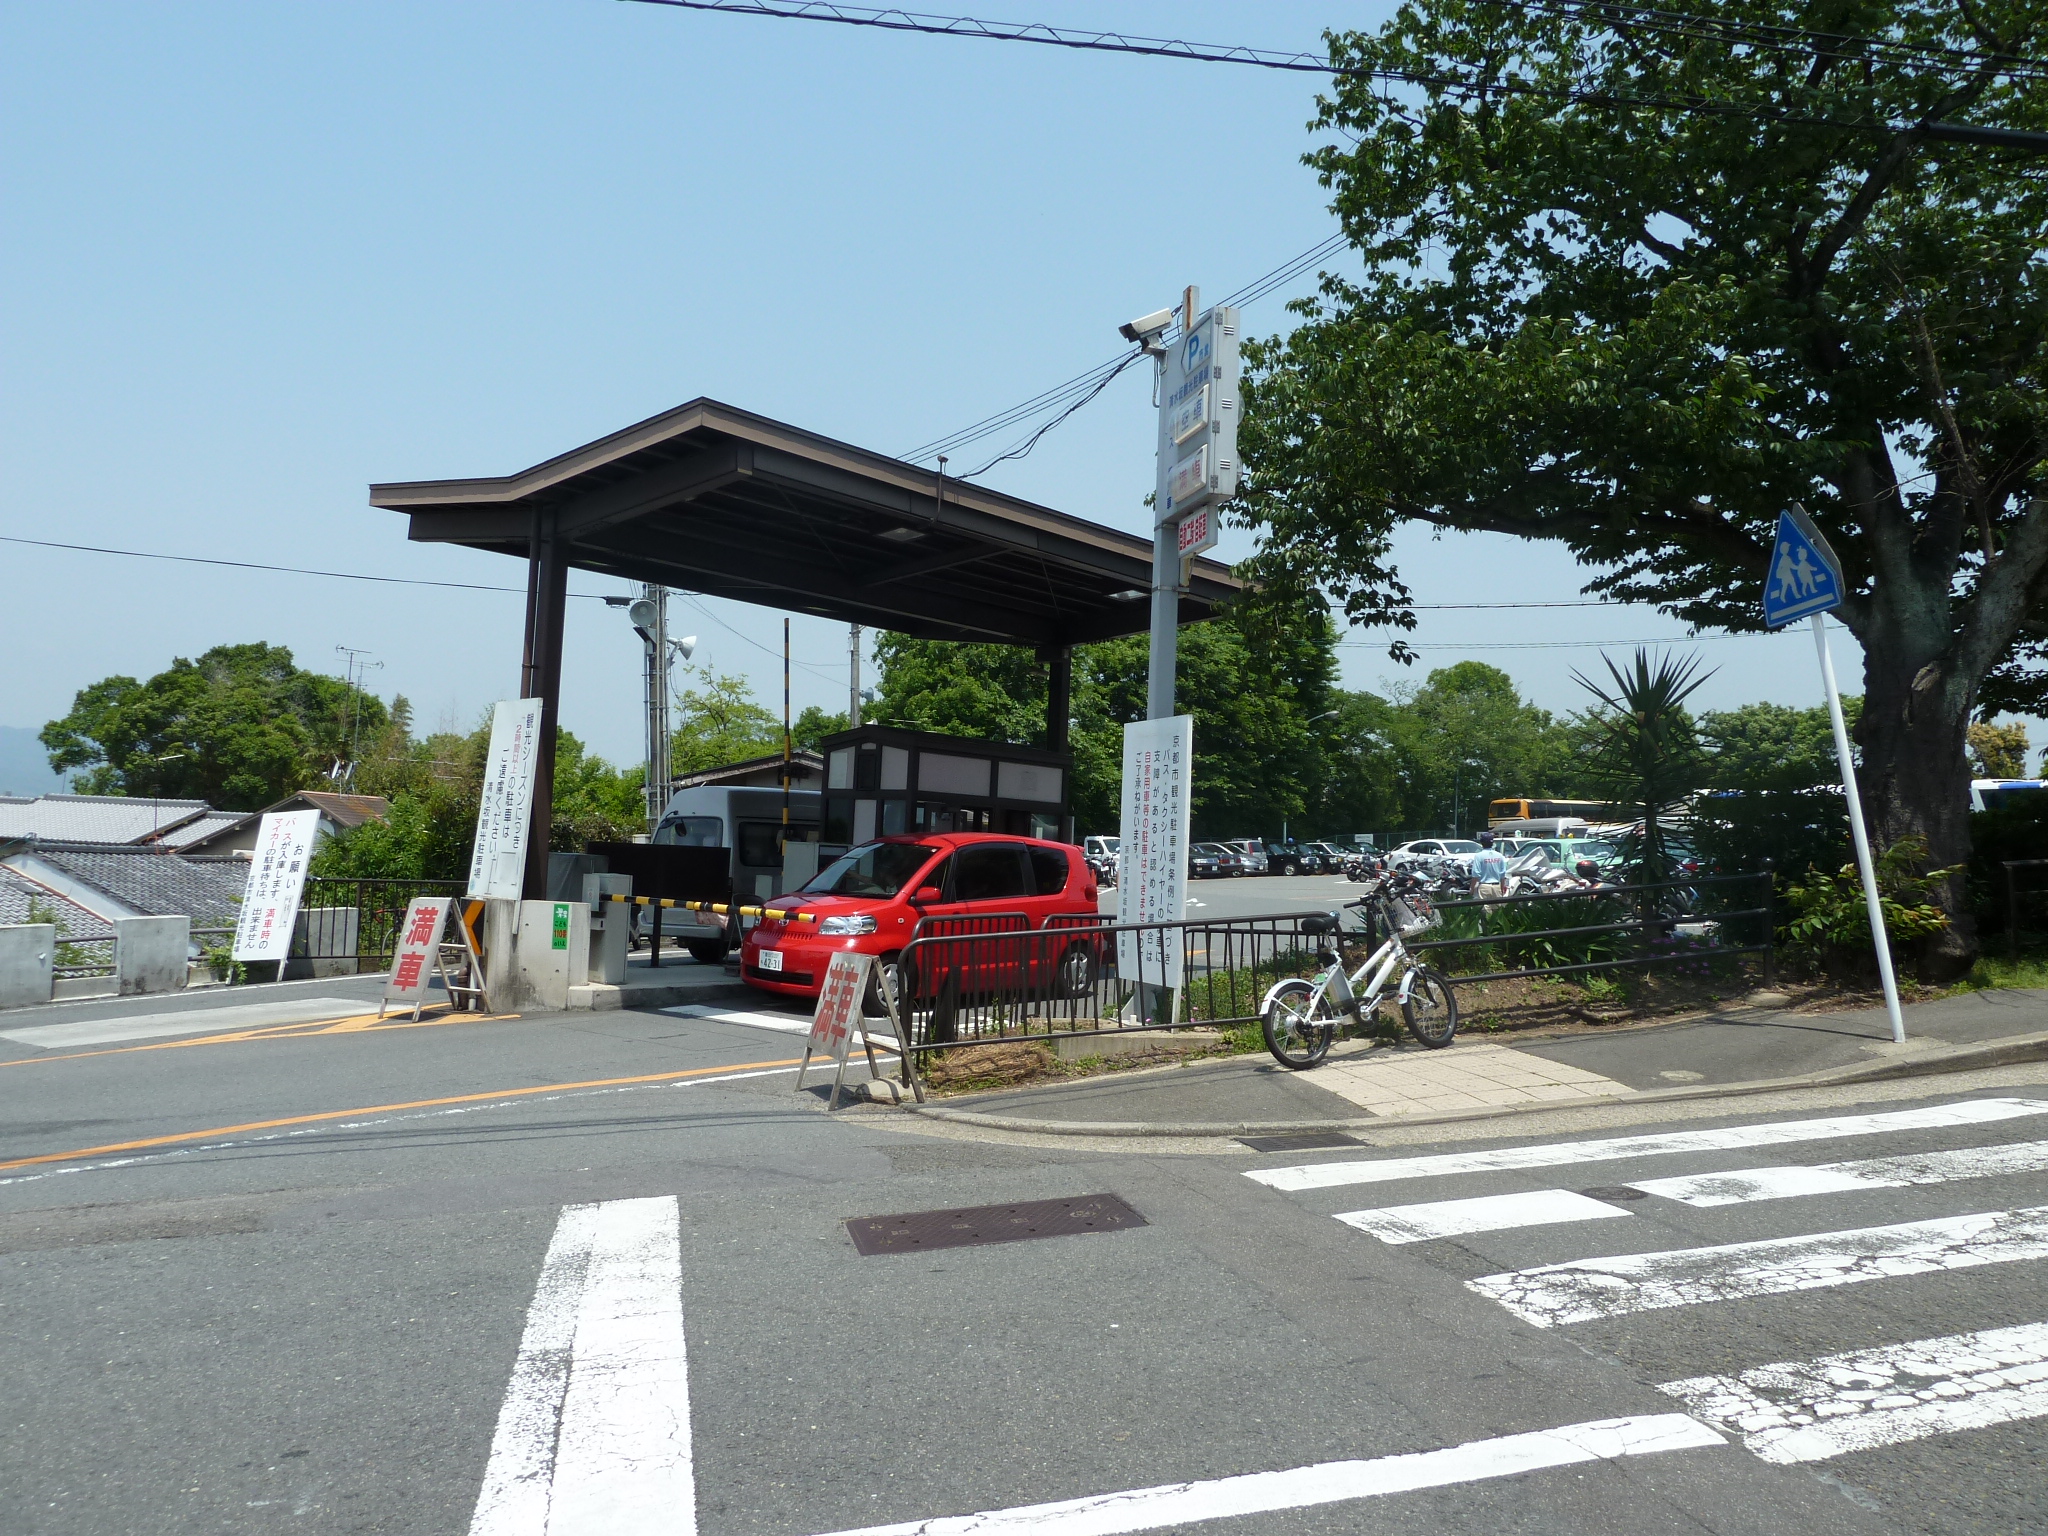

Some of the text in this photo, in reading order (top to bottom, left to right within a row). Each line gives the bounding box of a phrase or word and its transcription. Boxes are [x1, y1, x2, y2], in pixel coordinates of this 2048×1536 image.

[1188, 334, 1199, 371] P
[503, 724, 522, 838] 2時間以上の駐車は
[513, 712, 534, 849] 観光シーズンにつき
[1133, 752, 1143, 859] ご了承ねがいます。
[286, 844, 303, 889] お願い
[474, 780, 494, 879] 清水坂観光駐車場
[1156, 749, 1171, 963] バス・タクシーハイヤーの車に
[244, 907, 262, 949] 出来ません
[258, 908, 276, 949] 満車時の
[393, 906, 439, 991] 満車
[764, 958, 780, 969] 42-31
[812, 962, 860, 1047] 満車
